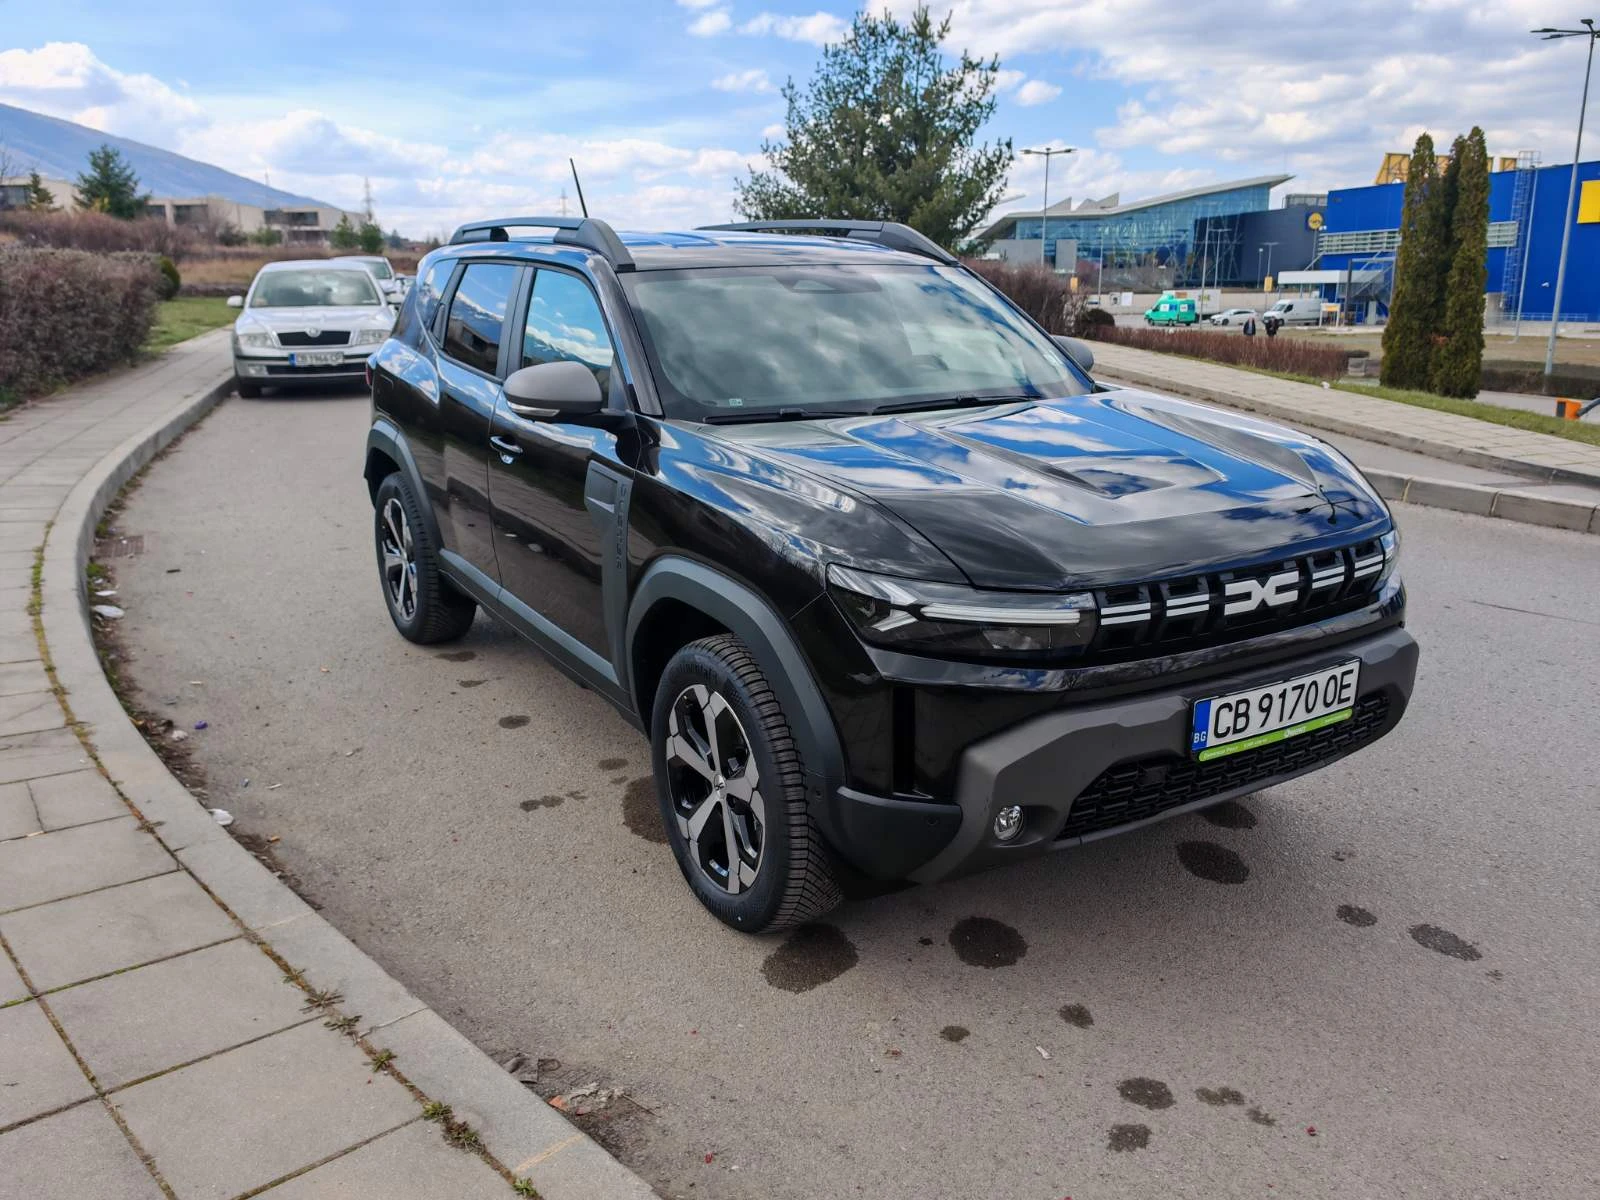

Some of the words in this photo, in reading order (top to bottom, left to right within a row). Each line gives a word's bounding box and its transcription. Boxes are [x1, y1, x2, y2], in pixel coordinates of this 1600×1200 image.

[1214, 698, 1250, 738] CB
[1258, 680, 1318, 728] 9170
[1323, 669, 1354, 708] OE
[1193, 731, 1207, 744] BG
